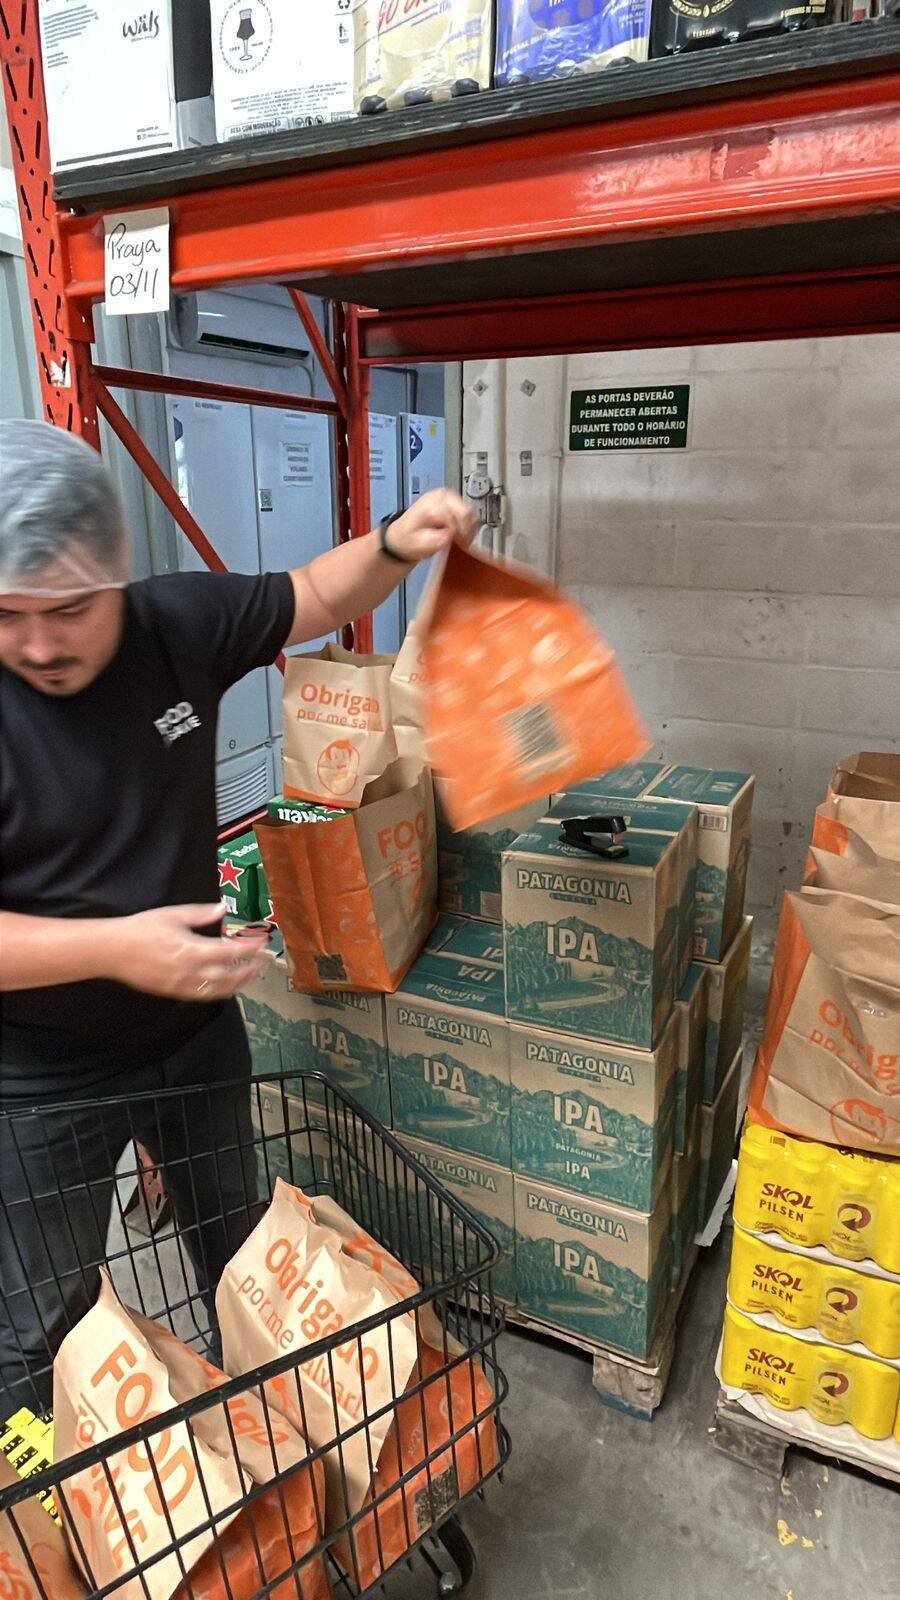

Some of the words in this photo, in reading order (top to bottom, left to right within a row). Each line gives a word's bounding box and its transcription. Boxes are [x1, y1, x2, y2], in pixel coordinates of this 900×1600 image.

[107, 223, 161, 267] Praya
[110, 267, 159, 299] 03/11
[585, 395, 596, 404] AS
[598, 393, 631, 403] PORTAS
[633, 389, 674, 401] DEVERÃO
[580, 408, 636, 418] PERMANECER
[638, 406, 678, 416] ABERTAS
[571, 423, 610, 433] DURANTE
[612, 422, 635, 432] TODO
[638, 421, 644, 430] O
[646, 420, 686, 430] HORÁRIO
[410, 435, 417, 449] 2
[584, 438, 595, 447] DE
[597, 436, 670, 447] FUNCIONAMENTO
[296, 708, 323, 722] por
[326, 713, 348, 726] me
[516, 869, 632, 905] PATAGONIA
[546, 925, 600, 963] IPA
[425, 983, 487, 1003] PATAGONIA
[310, 1022, 350, 1056] IPA
[397, 1007, 492, 1048] PATAGONIA
[423, 1057, 469, 1093] IPA
[526, 1041, 635, 1085] PATAGONIA
[553, 1094, 604, 1135] IPA
[555, 1142, 601, 1162] PATAGONIA
[565, 1162, 591, 1180] IPA
[761, 1182, 814, 1210] SKOL
[527, 1192, 629, 1243] PATAGONIA
[759, 1199, 804, 1223] PILSEN
[553, 1242, 601, 1282] IPA
[751, 1280, 793, 1303] PILSEN
[753, 1263, 803, 1292] SKOL
[237, 1274, 271, 1312] por
[265, 1310, 294, 1350] me
[744, 1364, 786, 1386] PILSEN
[747, 1348, 796, 1376] SKOL
[90, 1340, 197, 1516] FOOD
